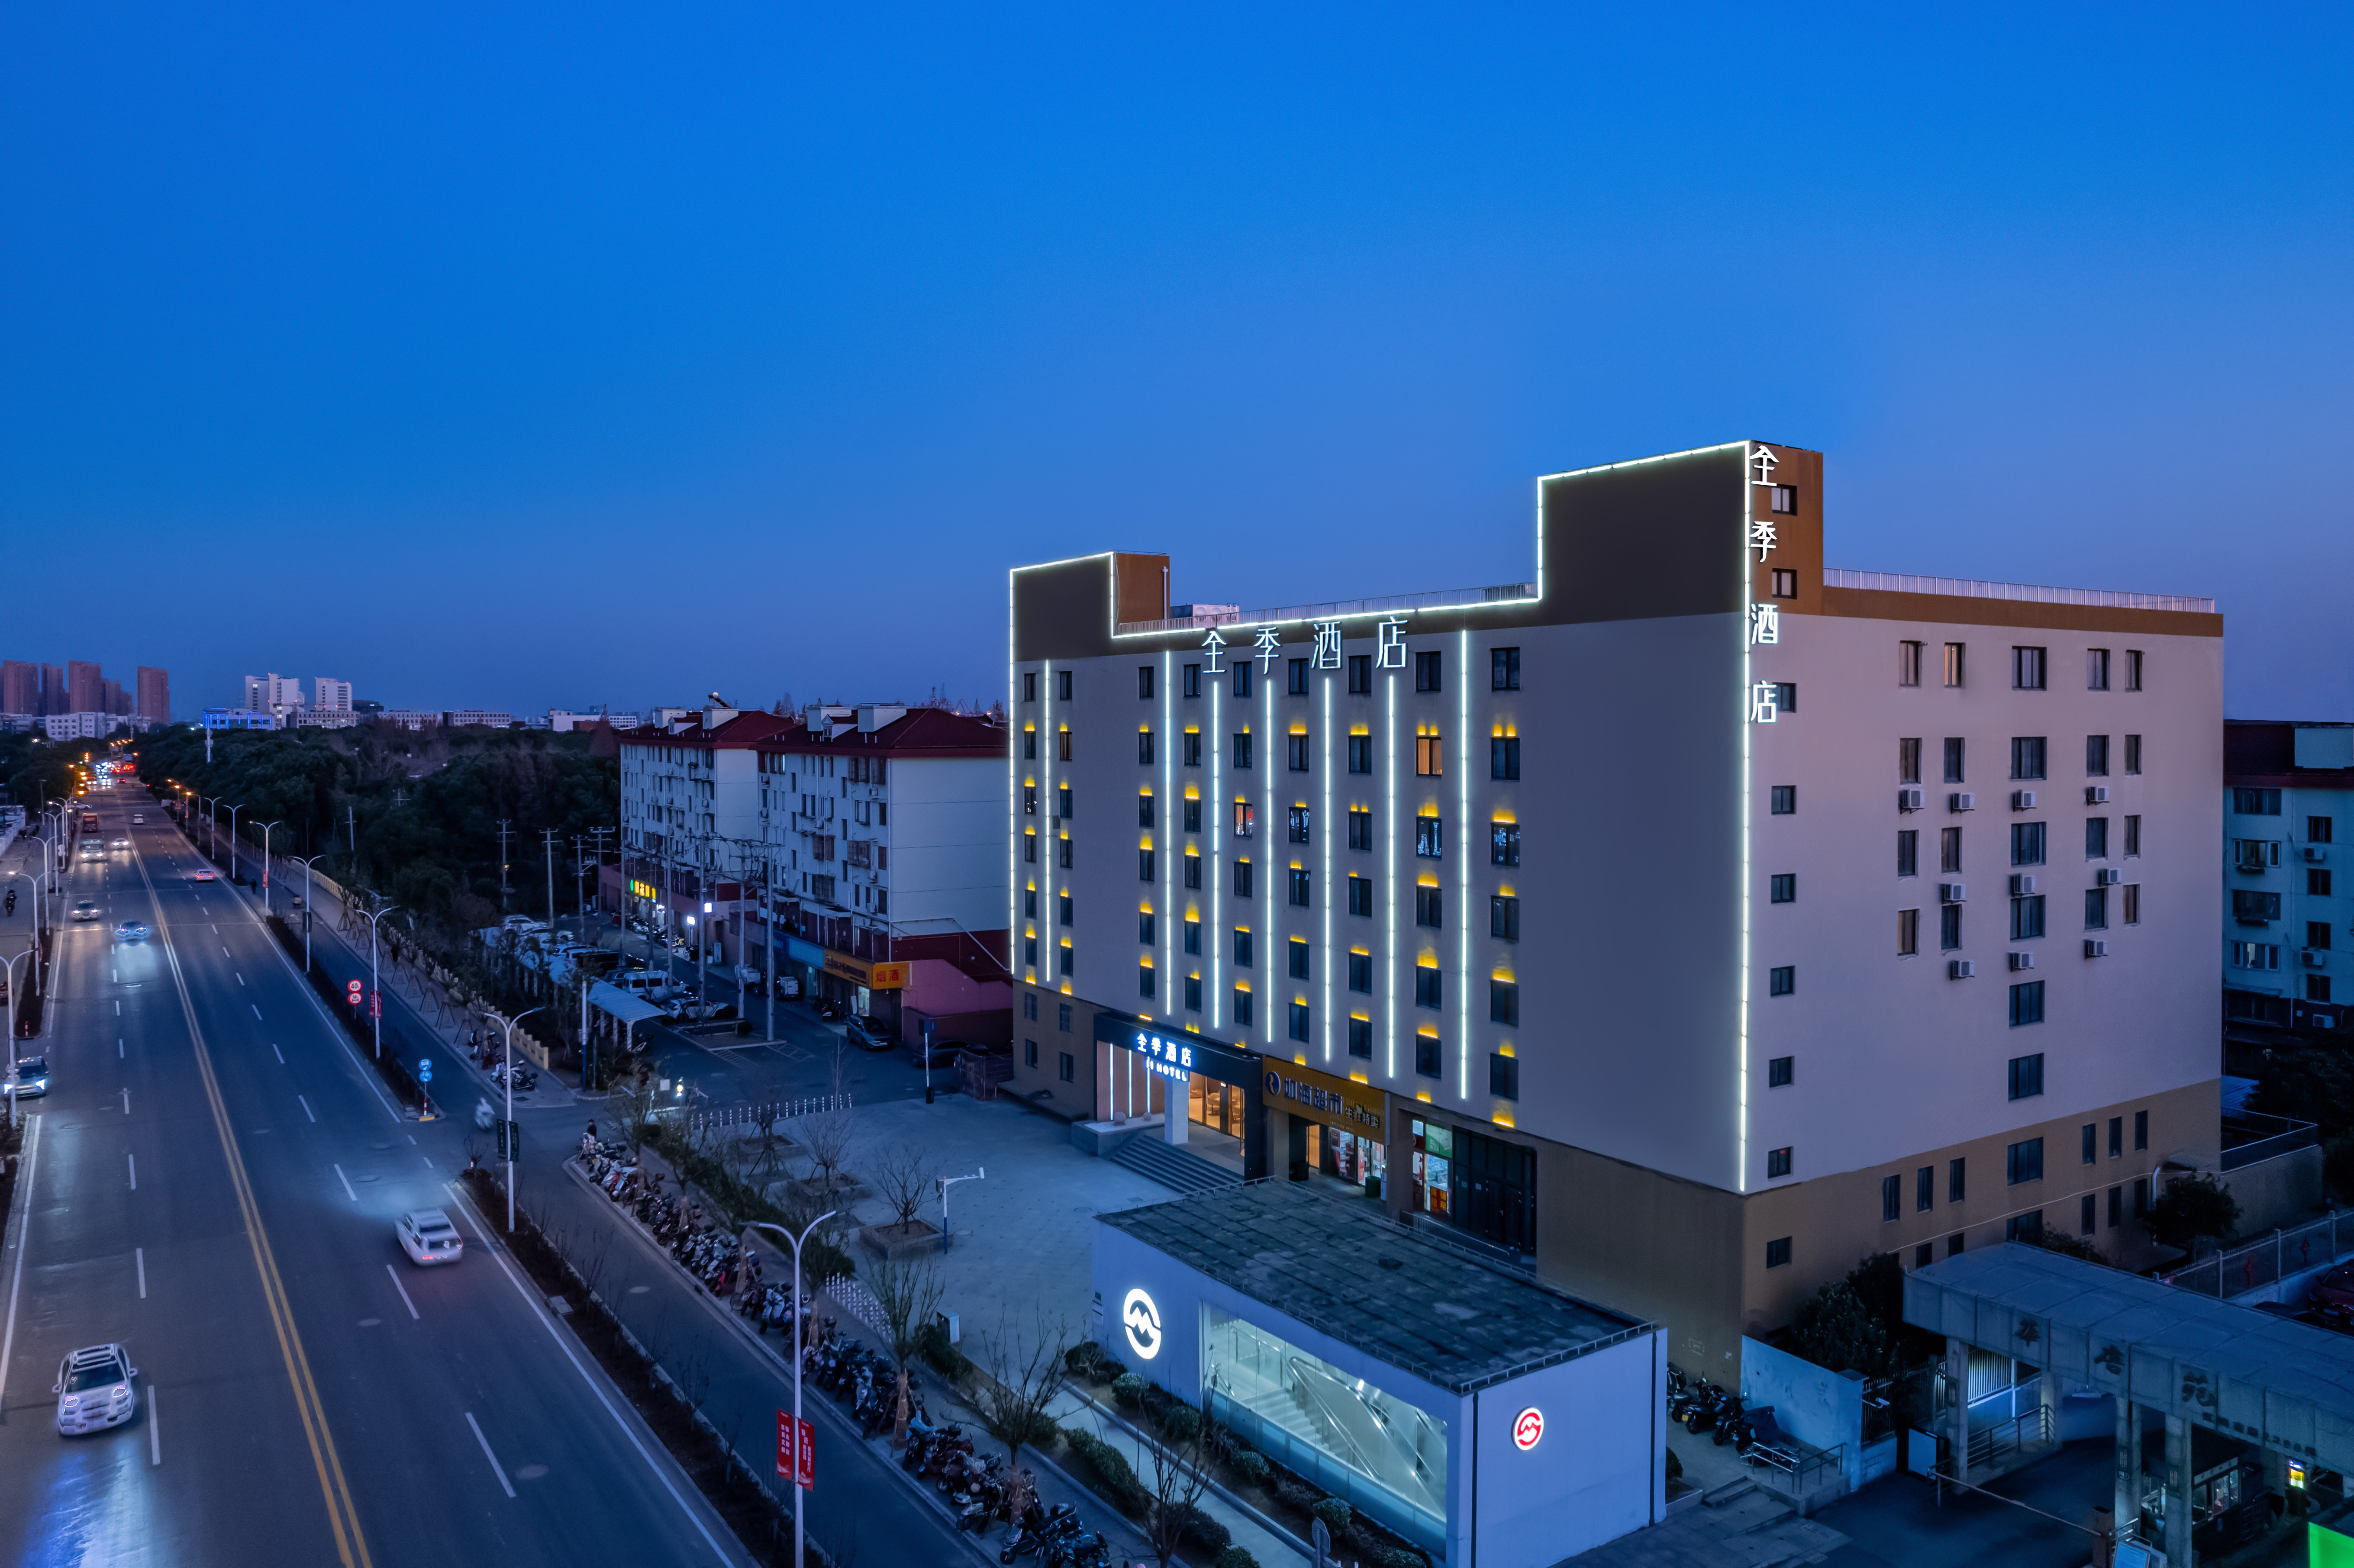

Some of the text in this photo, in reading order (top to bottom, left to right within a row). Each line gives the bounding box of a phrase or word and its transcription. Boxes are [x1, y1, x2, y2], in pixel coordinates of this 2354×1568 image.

[1749, 445, 1779, 724] 全季酒店
[1201, 615, 1408, 675] 全季酒店
[876, 969, 899, 982] 烟酒
[1137, 1033, 1191, 1067] 全季酒店
[1284, 1078, 1343, 1115] 如海超市
